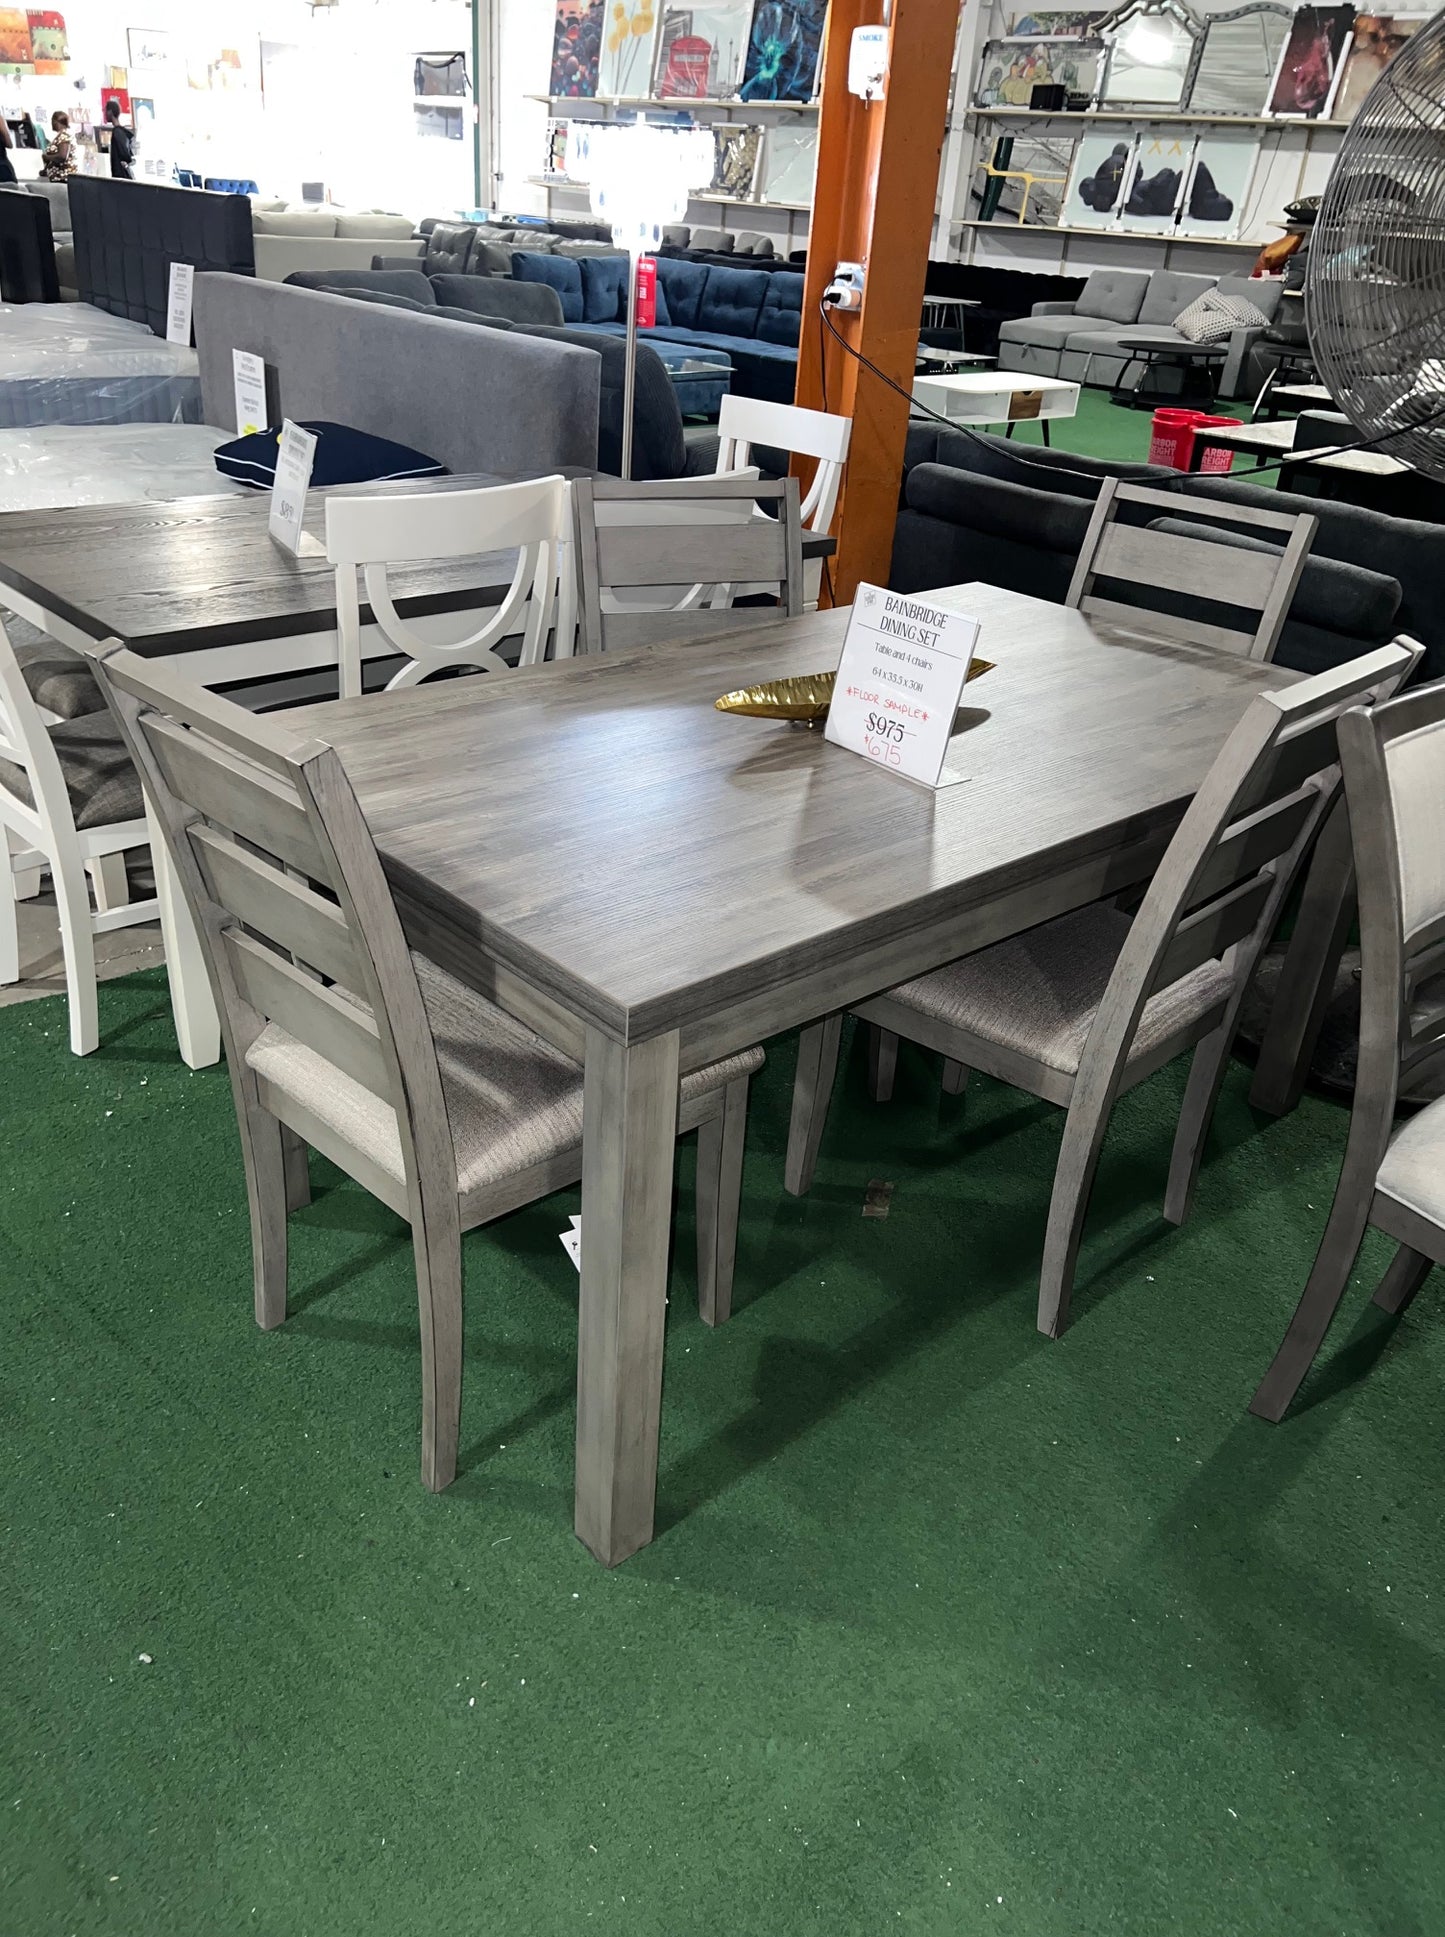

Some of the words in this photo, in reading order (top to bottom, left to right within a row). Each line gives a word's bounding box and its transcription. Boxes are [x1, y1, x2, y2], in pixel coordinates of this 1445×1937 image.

[859, 34, 883, 42] SMOKE
[1201, 456, 1230, 466] REIGHT
[884, 596, 949, 630] BAINBRIDGE
[879, 615, 917, 640] DINING
[916, 628, 941, 648] SET
[875, 641, 893, 656] Table
[892, 650, 906, 661] and
[906, 653, 912, 663] 4
[911, 656, 933, 671] chairs
[882, 671, 887, 680] x
[903, 679, 909, 688] x
[908, 679, 924, 693] 30H
[865, 711, 906, 743] $975
